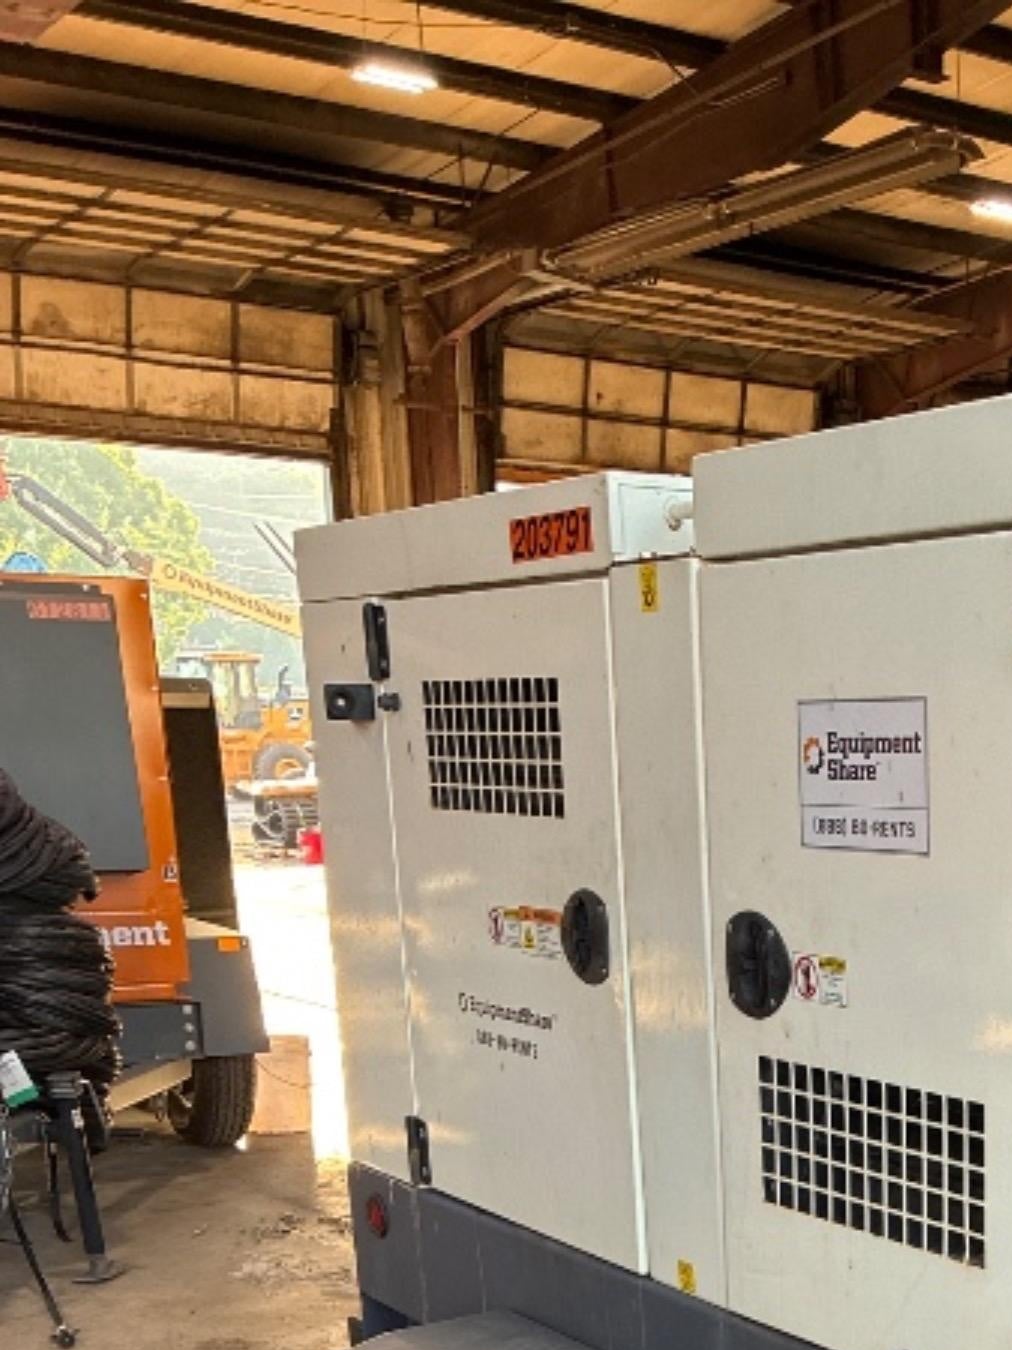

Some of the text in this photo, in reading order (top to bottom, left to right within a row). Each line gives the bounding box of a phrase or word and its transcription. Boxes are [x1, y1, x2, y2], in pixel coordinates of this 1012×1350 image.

[511, 508, 591, 560] 203791
[826, 731, 922, 759] Equipment
[827, 759, 877, 781] Share
